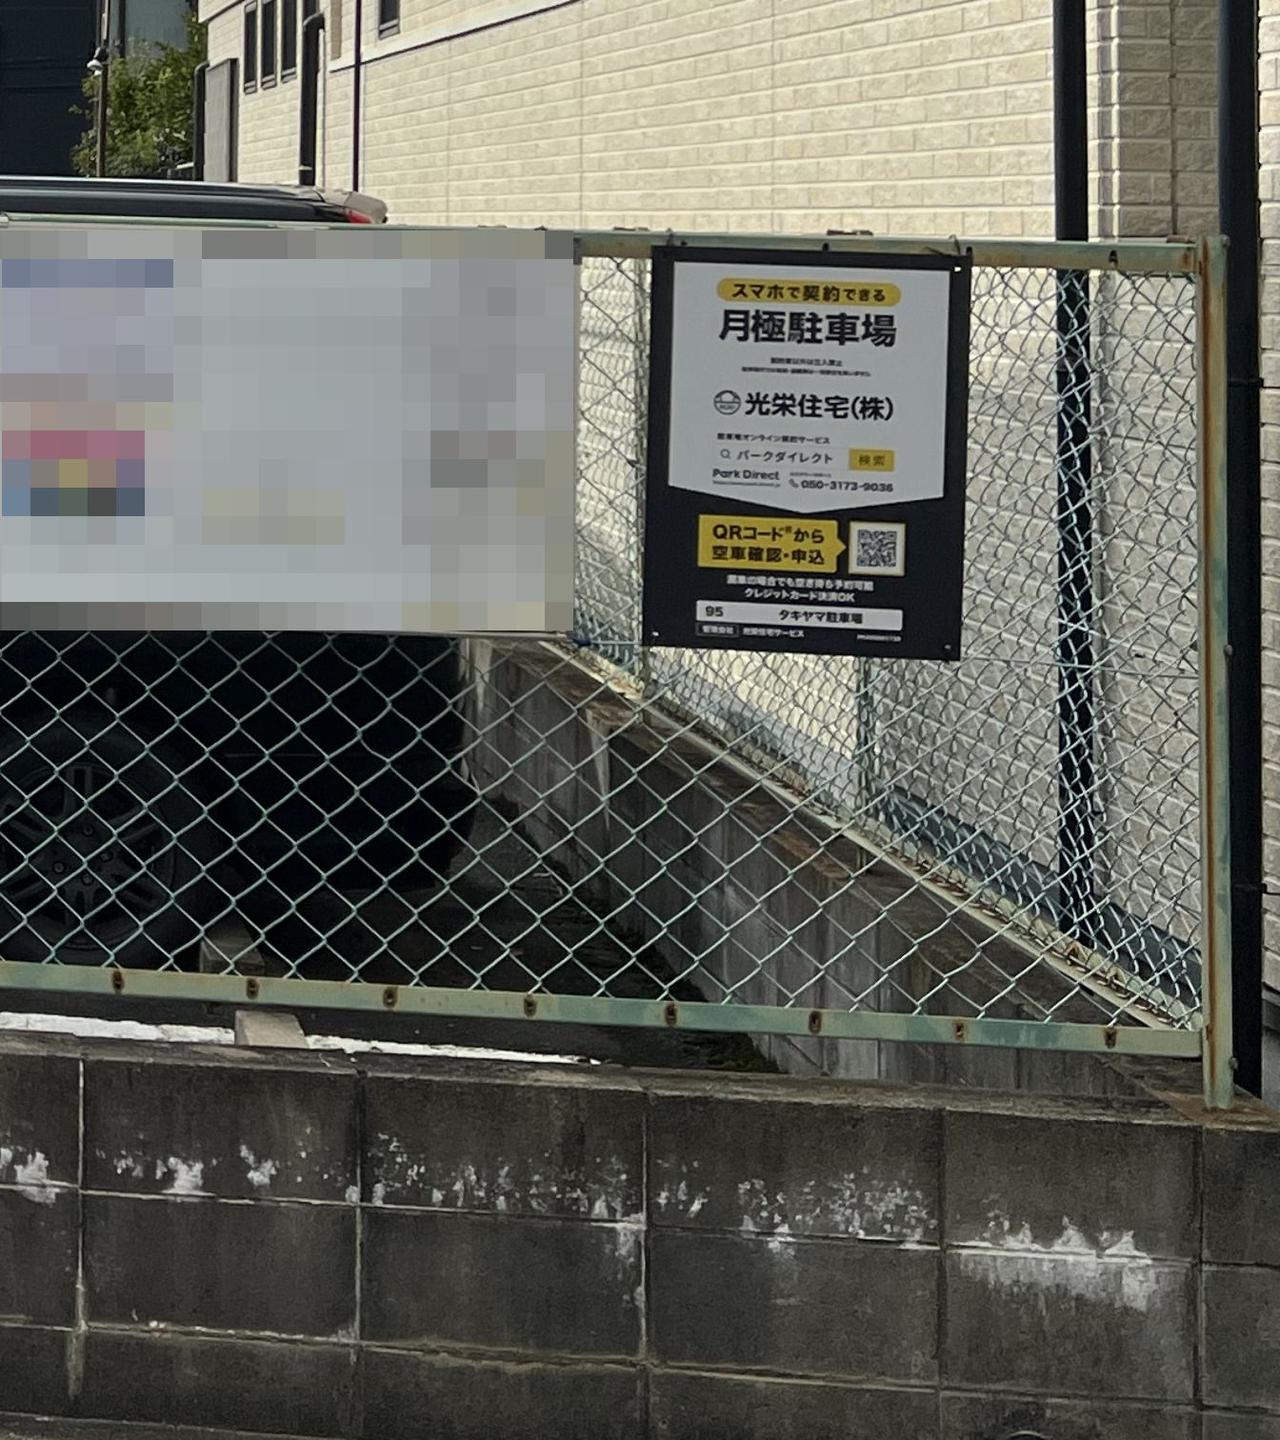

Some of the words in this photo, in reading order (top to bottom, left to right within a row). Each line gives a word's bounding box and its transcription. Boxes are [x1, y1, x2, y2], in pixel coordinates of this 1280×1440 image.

[732, 283, 886, 302] スマホで契約できる
[719, 309, 897, 347] 月極駐車場
[745, 392, 894, 421] 光栄住宅(株)
[737, 449, 832, 465] パークダイレクト
[713, 469, 740, 479] Park
[743, 470, 780, 481] Direct
[712, 546, 825, 565] 空車確認・申込
[705, 606, 724, 618] 95
